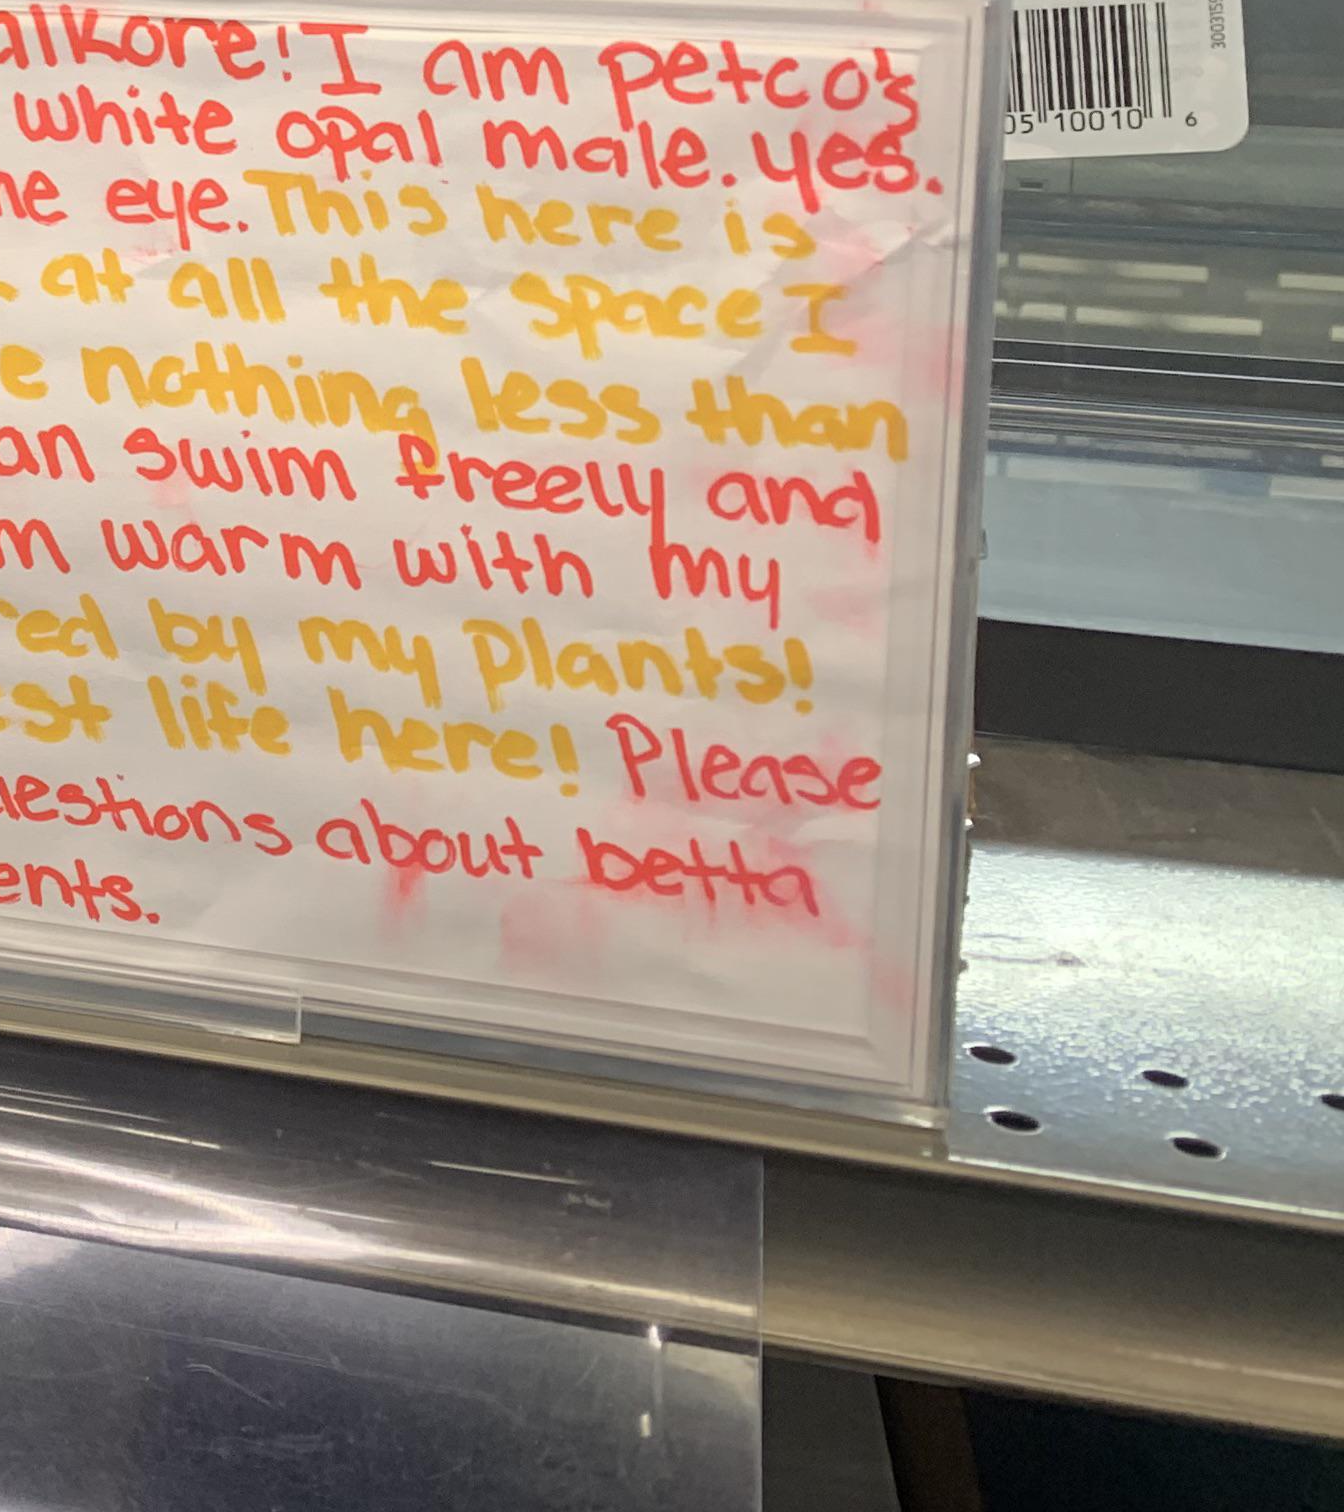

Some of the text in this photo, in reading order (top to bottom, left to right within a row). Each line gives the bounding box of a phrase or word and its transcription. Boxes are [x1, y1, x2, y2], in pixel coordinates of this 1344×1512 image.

[423, 39, 569, 104] am
[1054, 108, 1143, 132] 10010
[1185, 111, 1198, 128] 6
[15, 84, 238, 155] white
[276, 109, 443, 182] opal
[483, 118, 737, 189] male.
[475, 182, 683, 252] here
[723, 196, 817, 259] is
[39, 247, 136, 305] at
[168, 256, 288, 323] all
[319, 251, 470, 334] the
[510, 271, 763, 360] space
[783, 281, 858, 357] I
[80, 340, 441, 475] nothing
[460, 355, 662, 445] less
[685, 374, 909, 462] than
[124, 426, 358, 502] swim
[395, 432, 666, 548] freely
[706, 469, 881, 546] and
[100, 518, 361, 591] warm
[393, 523, 594, 598] with
[649, 541, 780, 630] my
[148, 597, 268, 696] by
[298, 616, 443, 710] my
[147, 674, 292, 755] life
[327, 685, 580, 797] here!
[606, 712, 882, 811] Please
[315, 797, 544, 880] about
[576, 826, 820, 918] betta
